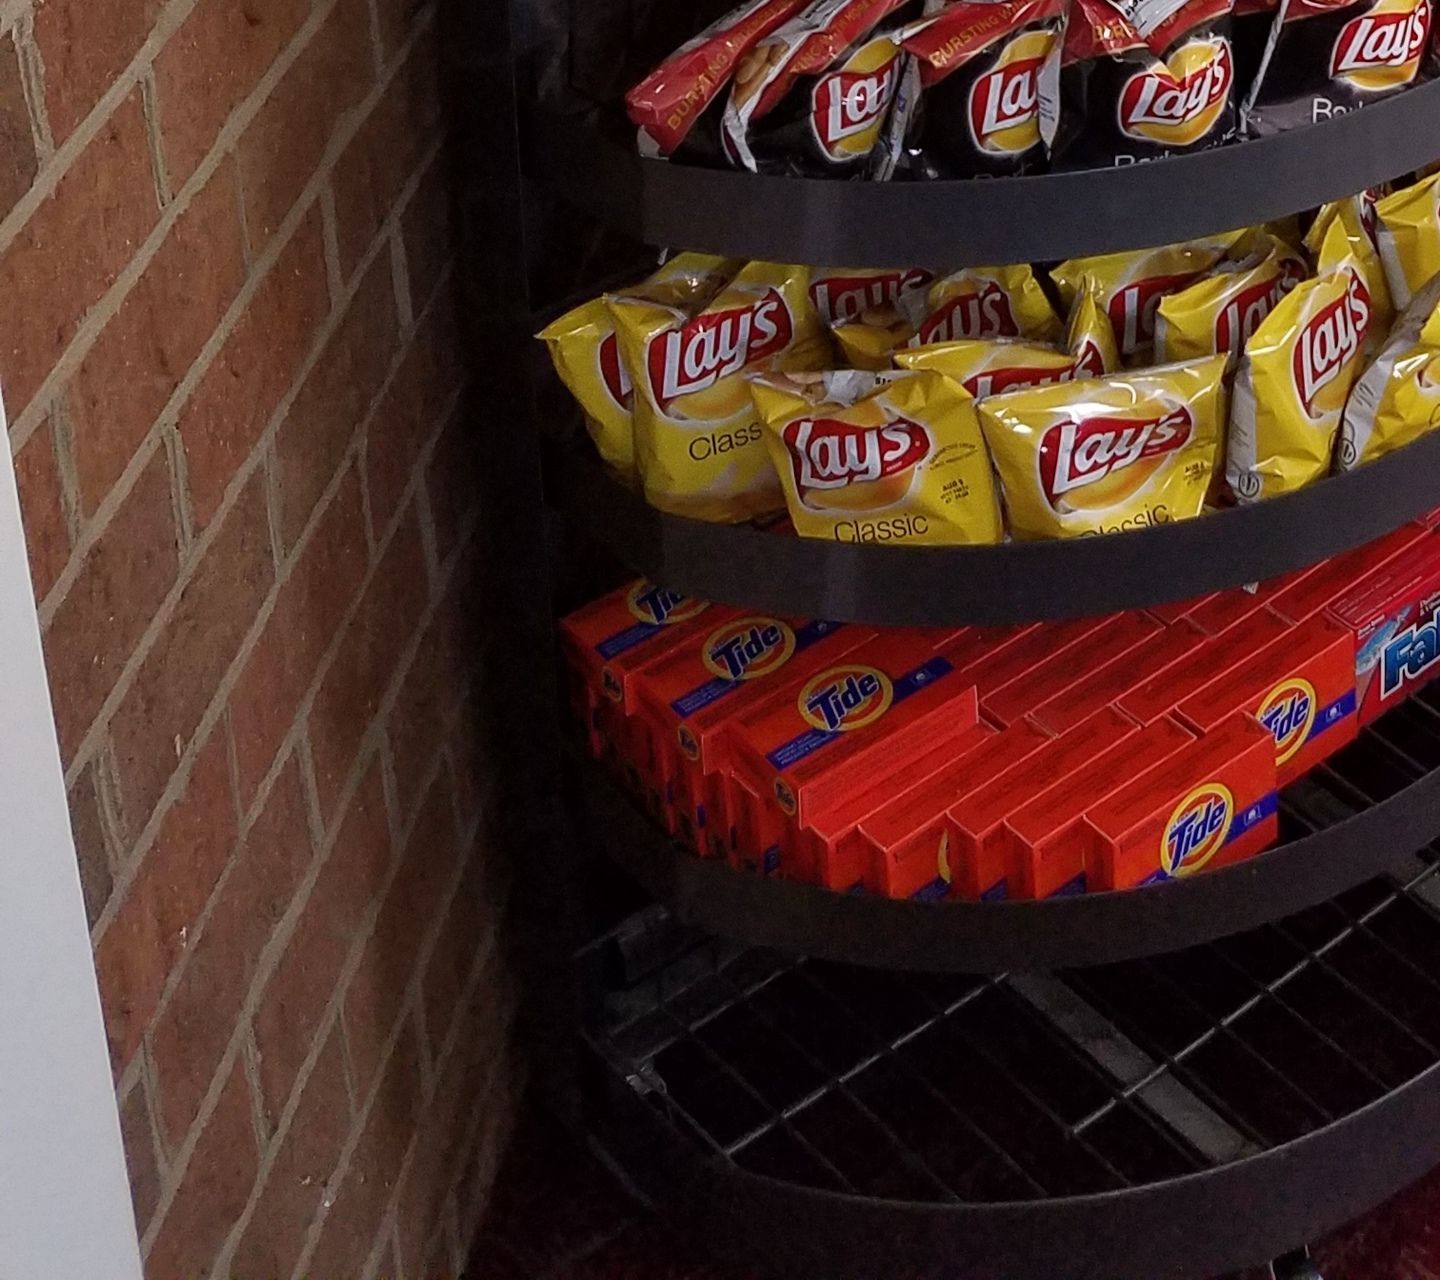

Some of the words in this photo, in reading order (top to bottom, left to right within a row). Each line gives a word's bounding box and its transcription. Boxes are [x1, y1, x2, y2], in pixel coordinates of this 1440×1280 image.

[1338, 5, 1428, 72] Lay's
[1129, 50, 1226, 127] Lay's
[661, 298, 779, 400] Lay's
[1301, 276, 1369, 403] Lay's
[688, 422, 763, 463] Class
[798, 419, 912, 491] Lay's
[1051, 413, 1185, 496] Lay's
[834, 513, 930, 545] Classic
[710, 623, 785, 680] Tide
[807, 672, 881, 731] Tide
[1168, 796, 1228, 875] Tide
